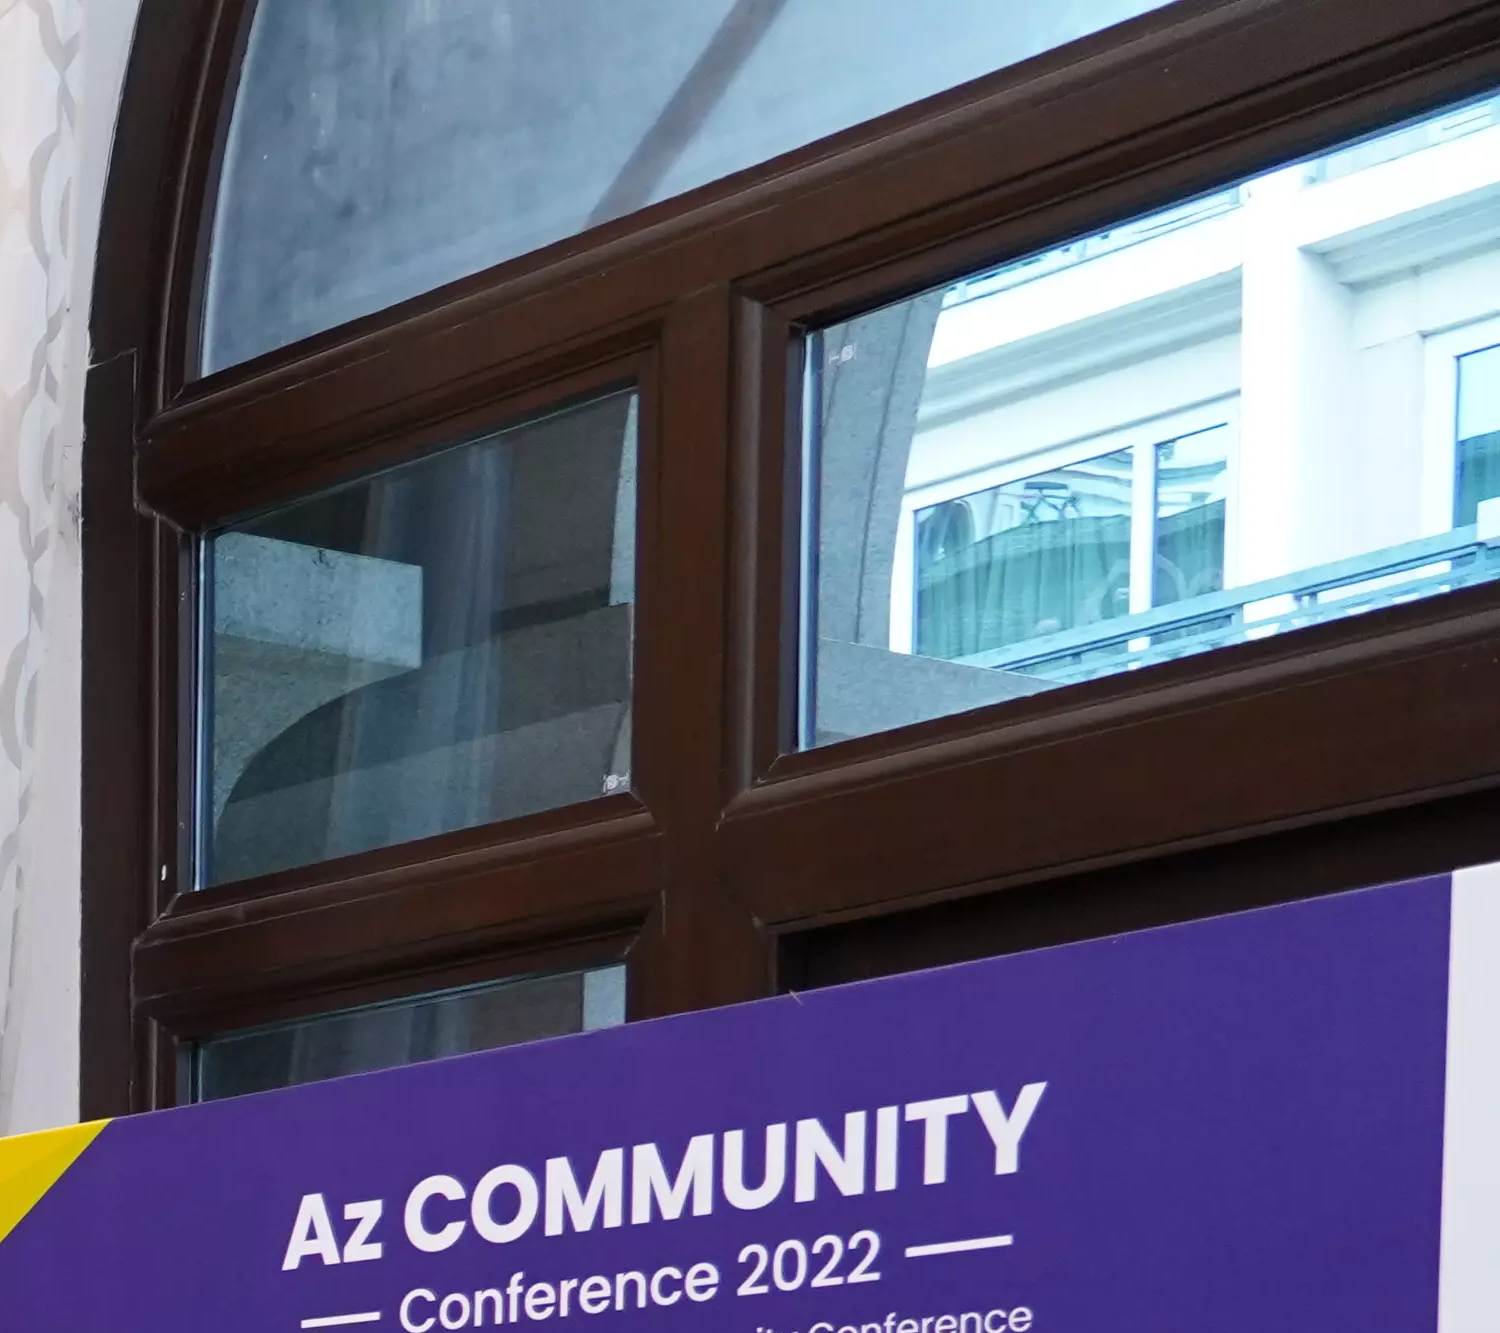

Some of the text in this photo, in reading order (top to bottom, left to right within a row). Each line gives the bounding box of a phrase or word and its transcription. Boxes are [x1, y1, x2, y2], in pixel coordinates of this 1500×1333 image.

[281, 1080, 1048, 1271] Az COMMUNITY
[399, 1229, 881, 1333] Conference 2022
